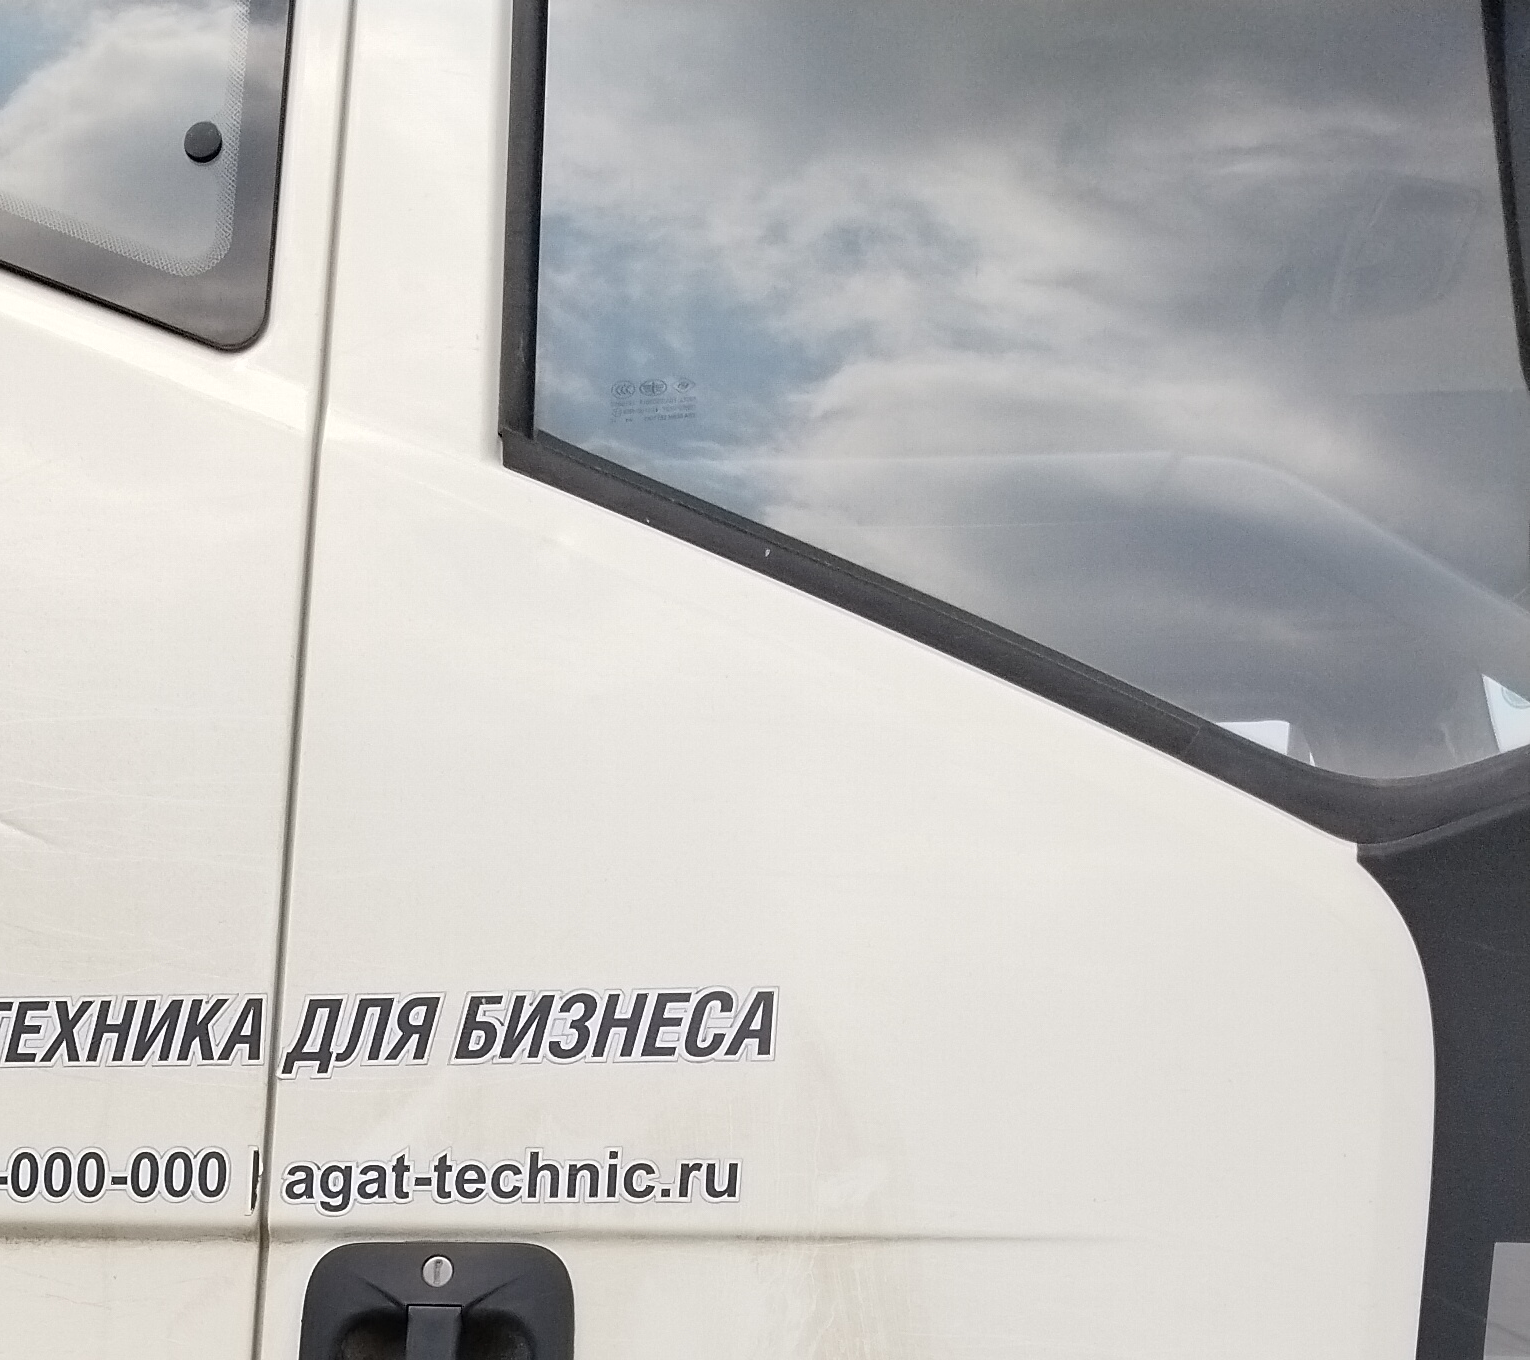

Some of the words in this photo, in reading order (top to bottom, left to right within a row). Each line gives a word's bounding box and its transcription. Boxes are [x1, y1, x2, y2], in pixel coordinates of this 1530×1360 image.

[279, 996, 442, 1075] ДЛЯ
[452, 990, 776, 1061] БИЗНЕСА
[284, 1150, 740, 1213] agat-technic.ru
